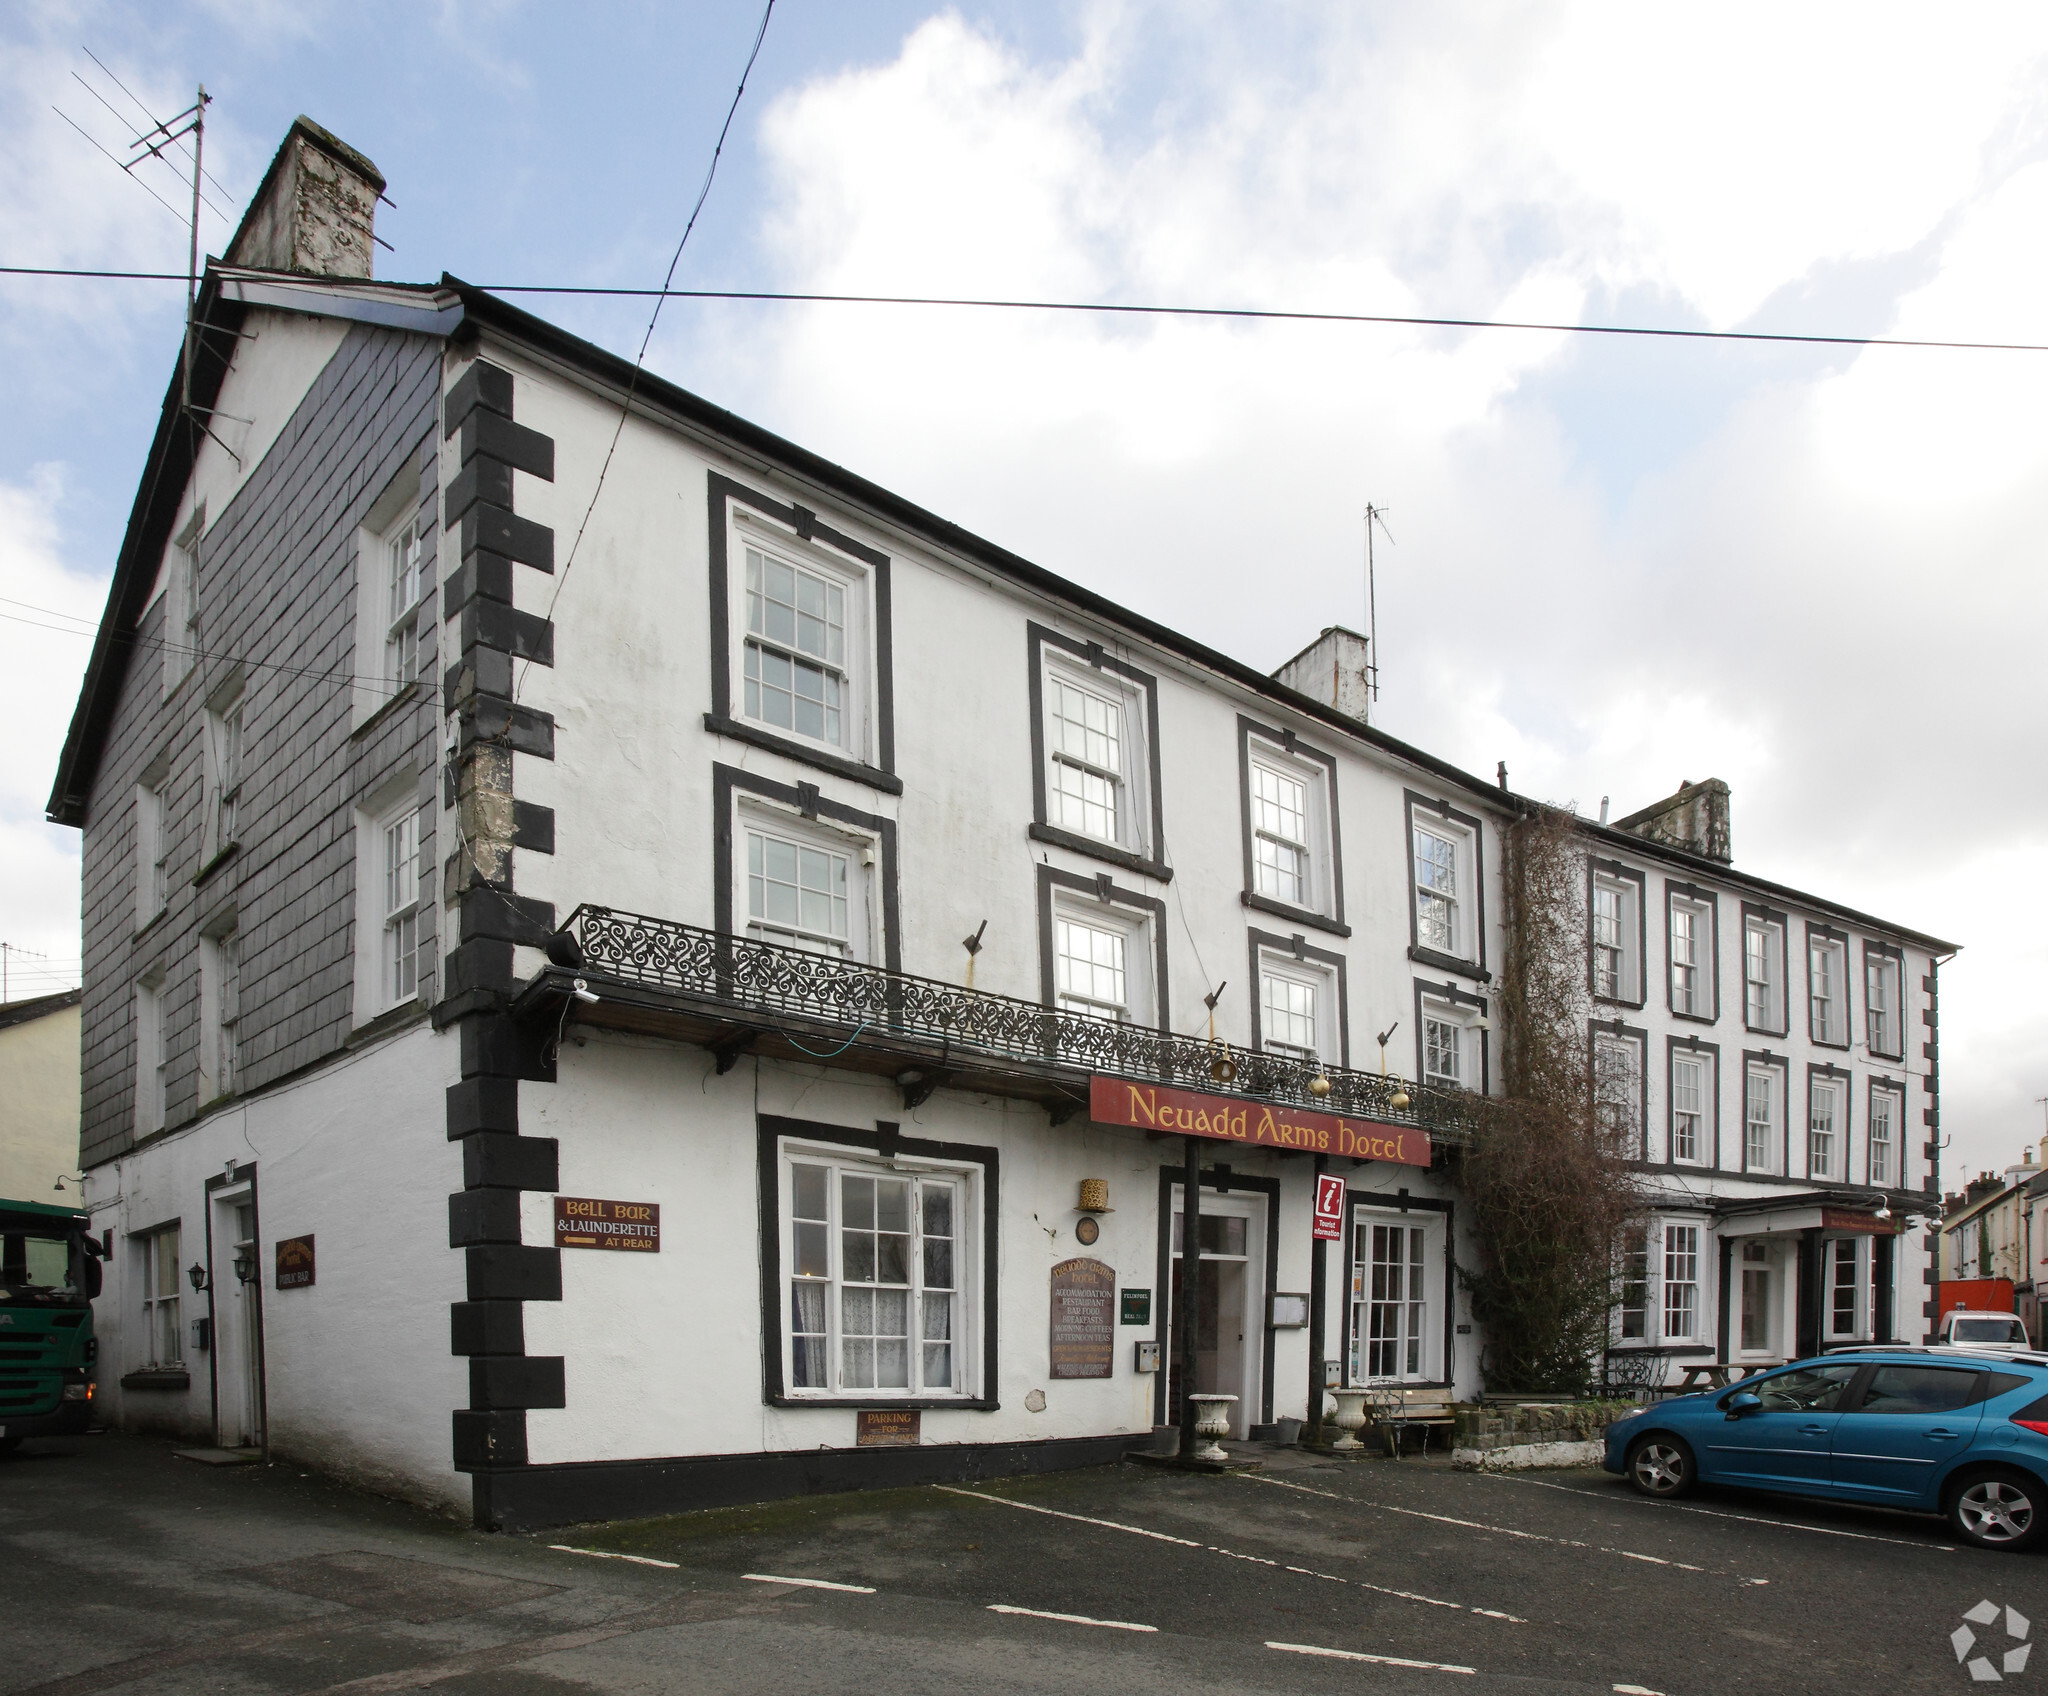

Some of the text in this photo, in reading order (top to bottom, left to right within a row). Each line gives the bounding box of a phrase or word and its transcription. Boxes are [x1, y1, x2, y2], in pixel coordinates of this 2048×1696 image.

[1126, 1085, 1248, 1138] Neuadd
[1257, 1107, 1330, 1150] Arms
[1319, 1220, 1336, 1228] Tourist
[604, 1237, 653, 1249] AT REAR
[297, 1270, 309, 1282] BAR
[1055, 1288, 1112, 1298] ACCOMMODATION
[1063, 1298, 1104, 1306] RESTAURANT
[1082, 1307, 1100, 1315] FOOD
[867, 1413, 912, 1424] PARKING
[882, 1425, 898, 1433] FOR
